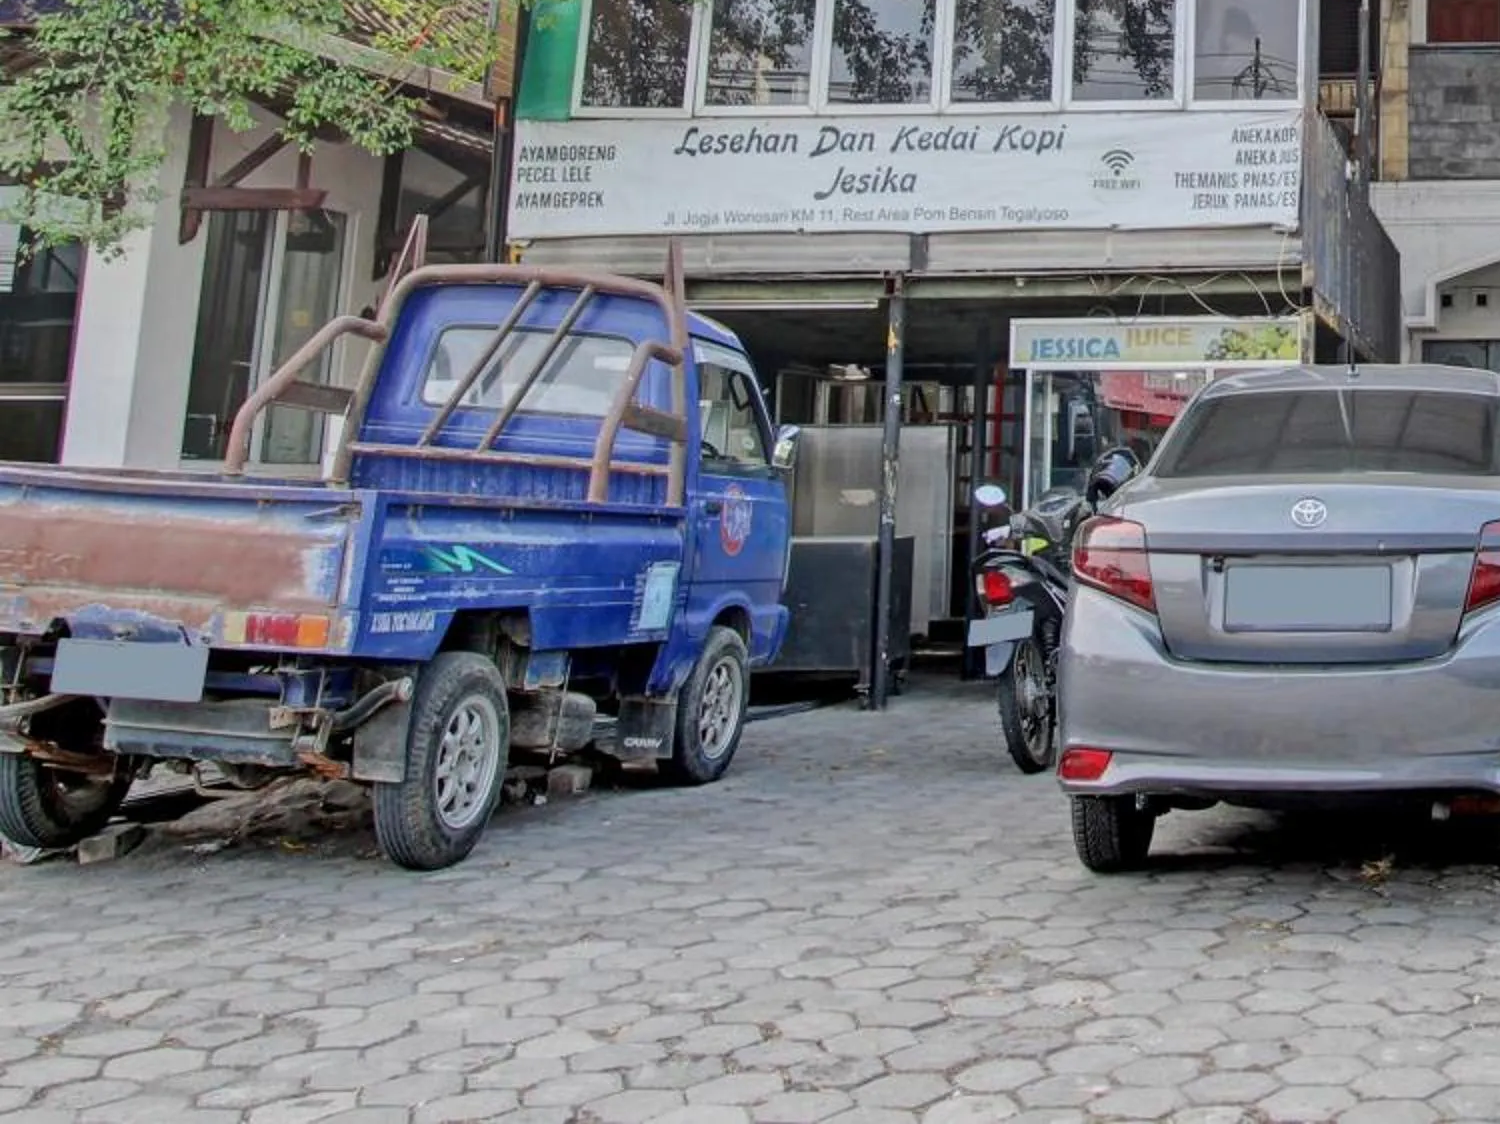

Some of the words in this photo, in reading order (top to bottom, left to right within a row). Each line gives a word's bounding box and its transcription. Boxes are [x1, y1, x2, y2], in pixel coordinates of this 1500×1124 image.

[674, 126, 799, 157] Lesehan
[809, 126, 875, 157] Dan
[890, 125, 980, 154] Kedai
[992, 124, 1068, 155] Kopi
[517, 167, 557, 183] PECEL
[562, 166, 592, 182] LELE
[813, 166, 918, 200] Jesika
[792, 209, 815, 221] KM
[843, 207, 874, 221] Rest
[878, 208, 910, 221] Area
[914, 207, 946, 220] Pom
[950, 205, 995, 220] Bensin
[1192, 193, 1229, 209] JERUK
[1031, 338, 1121, 361] JESSICA
[1126, 327, 1194, 349] JUICE
